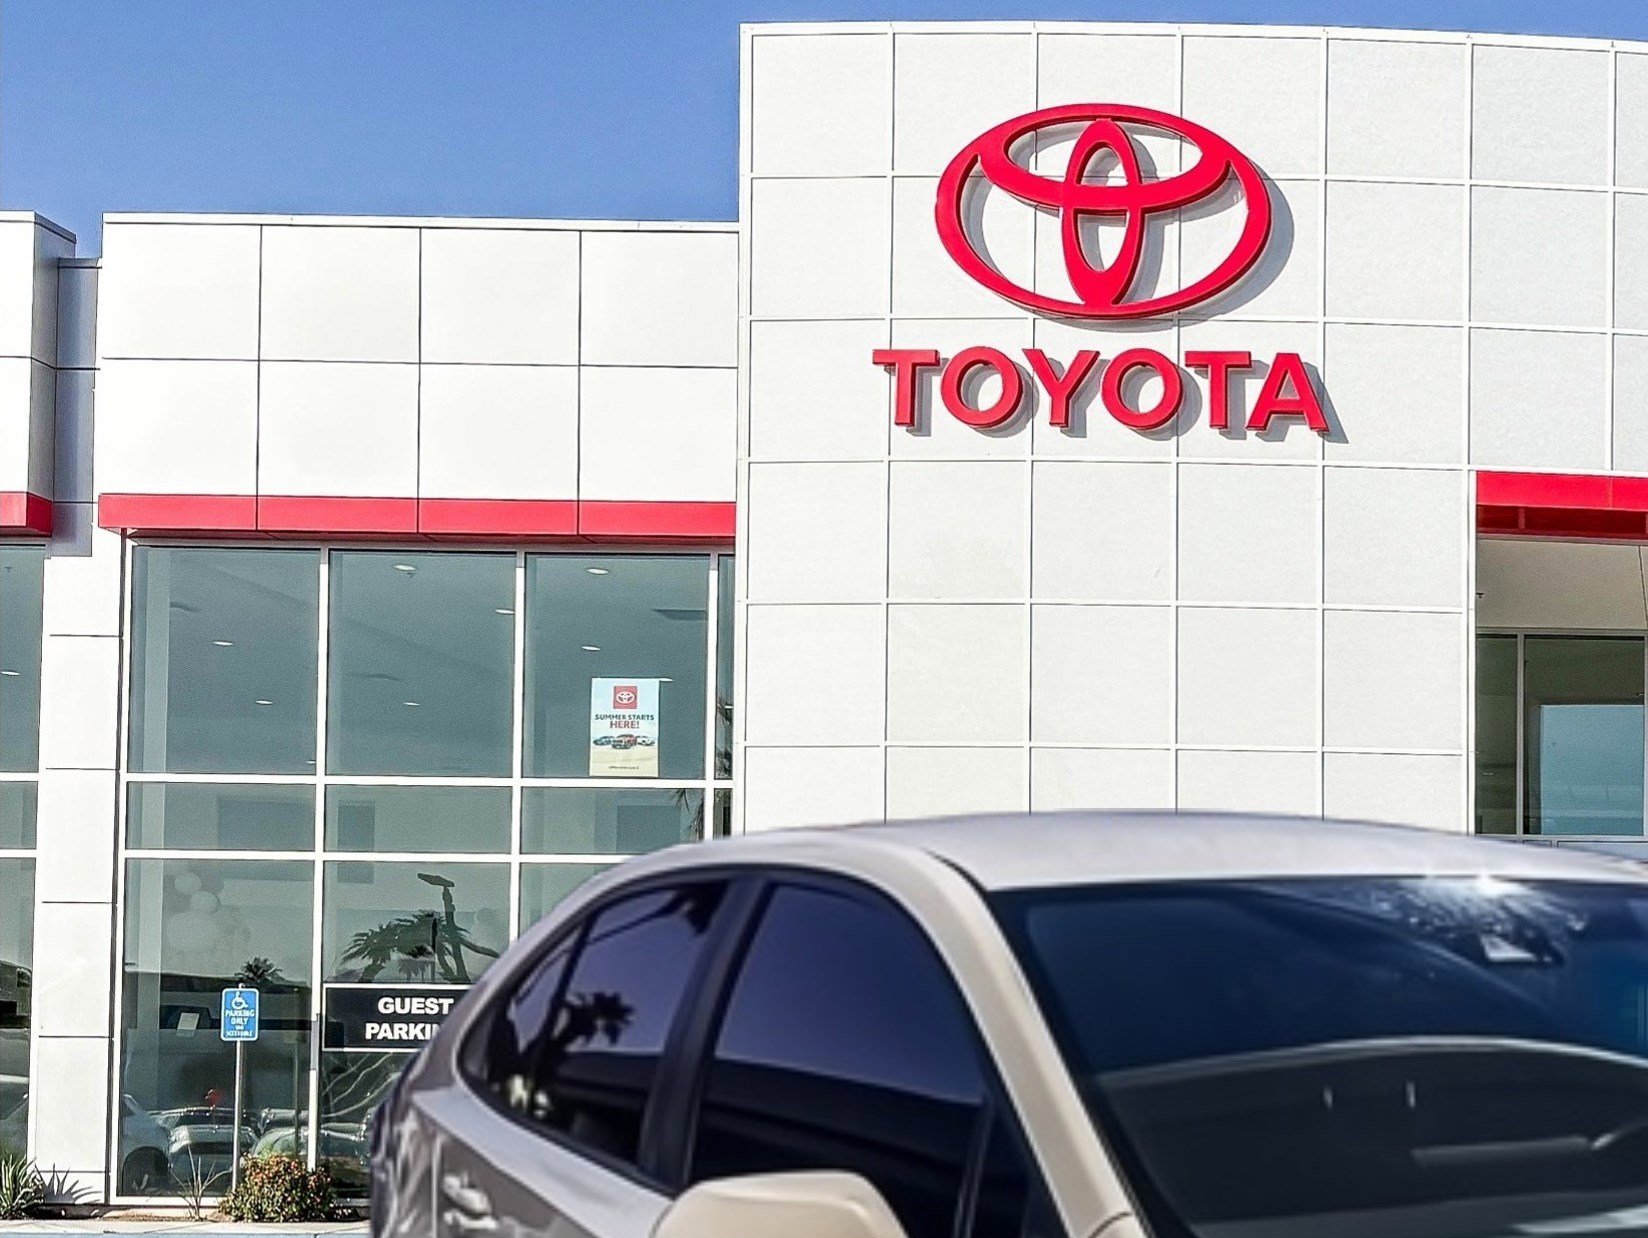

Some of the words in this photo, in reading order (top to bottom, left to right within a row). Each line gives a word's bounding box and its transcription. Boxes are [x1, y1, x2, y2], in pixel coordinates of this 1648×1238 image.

[872, 345, 1331, 432] TOYOTA
[594, 713, 627, 721] SUMMER
[628, 713, 655, 721] STARTS
[609, 720, 640, 729] HERE!
[377, 996, 455, 1015] GUEST
[364, 1022, 441, 1041] PARKI
